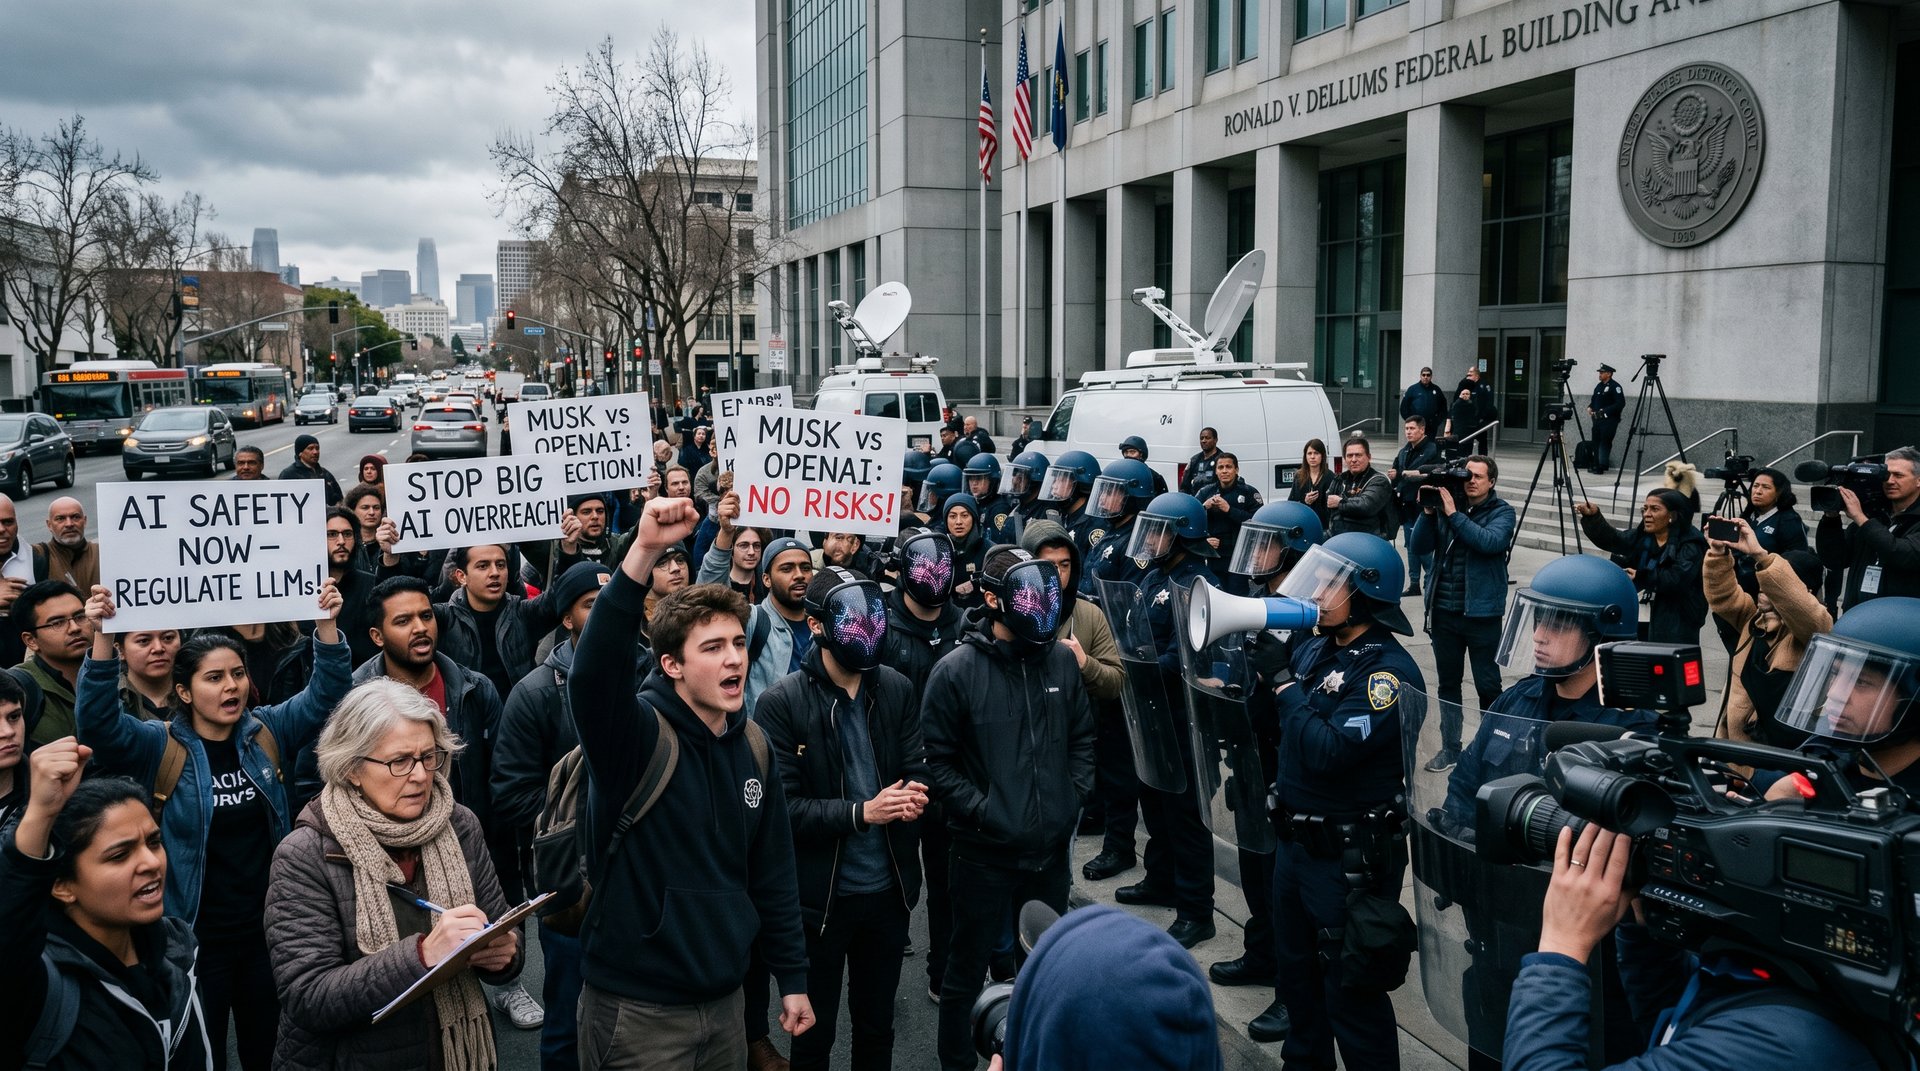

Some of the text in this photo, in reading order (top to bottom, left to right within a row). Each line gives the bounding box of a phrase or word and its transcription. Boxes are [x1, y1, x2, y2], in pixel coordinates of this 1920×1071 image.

[1224, 0, 1639, 137] RONALD V. DELLUMS FEDERAL BUILDING
[1620, 67, 1759, 168] UNITED STATES DISTRICT COURT
[527, 404, 596, 432] MUSK
[758, 415, 842, 449] MUSK
[407, 464, 543, 502] STOP BIG
[764, 452, 883, 485] OPENAI:
[118, 492, 310, 531] AI SAFETY
[747, 484, 895, 524] NO RISKS!
[399, 509, 433, 540] AI
[115, 564, 322, 609] REGULATE LLMs!
